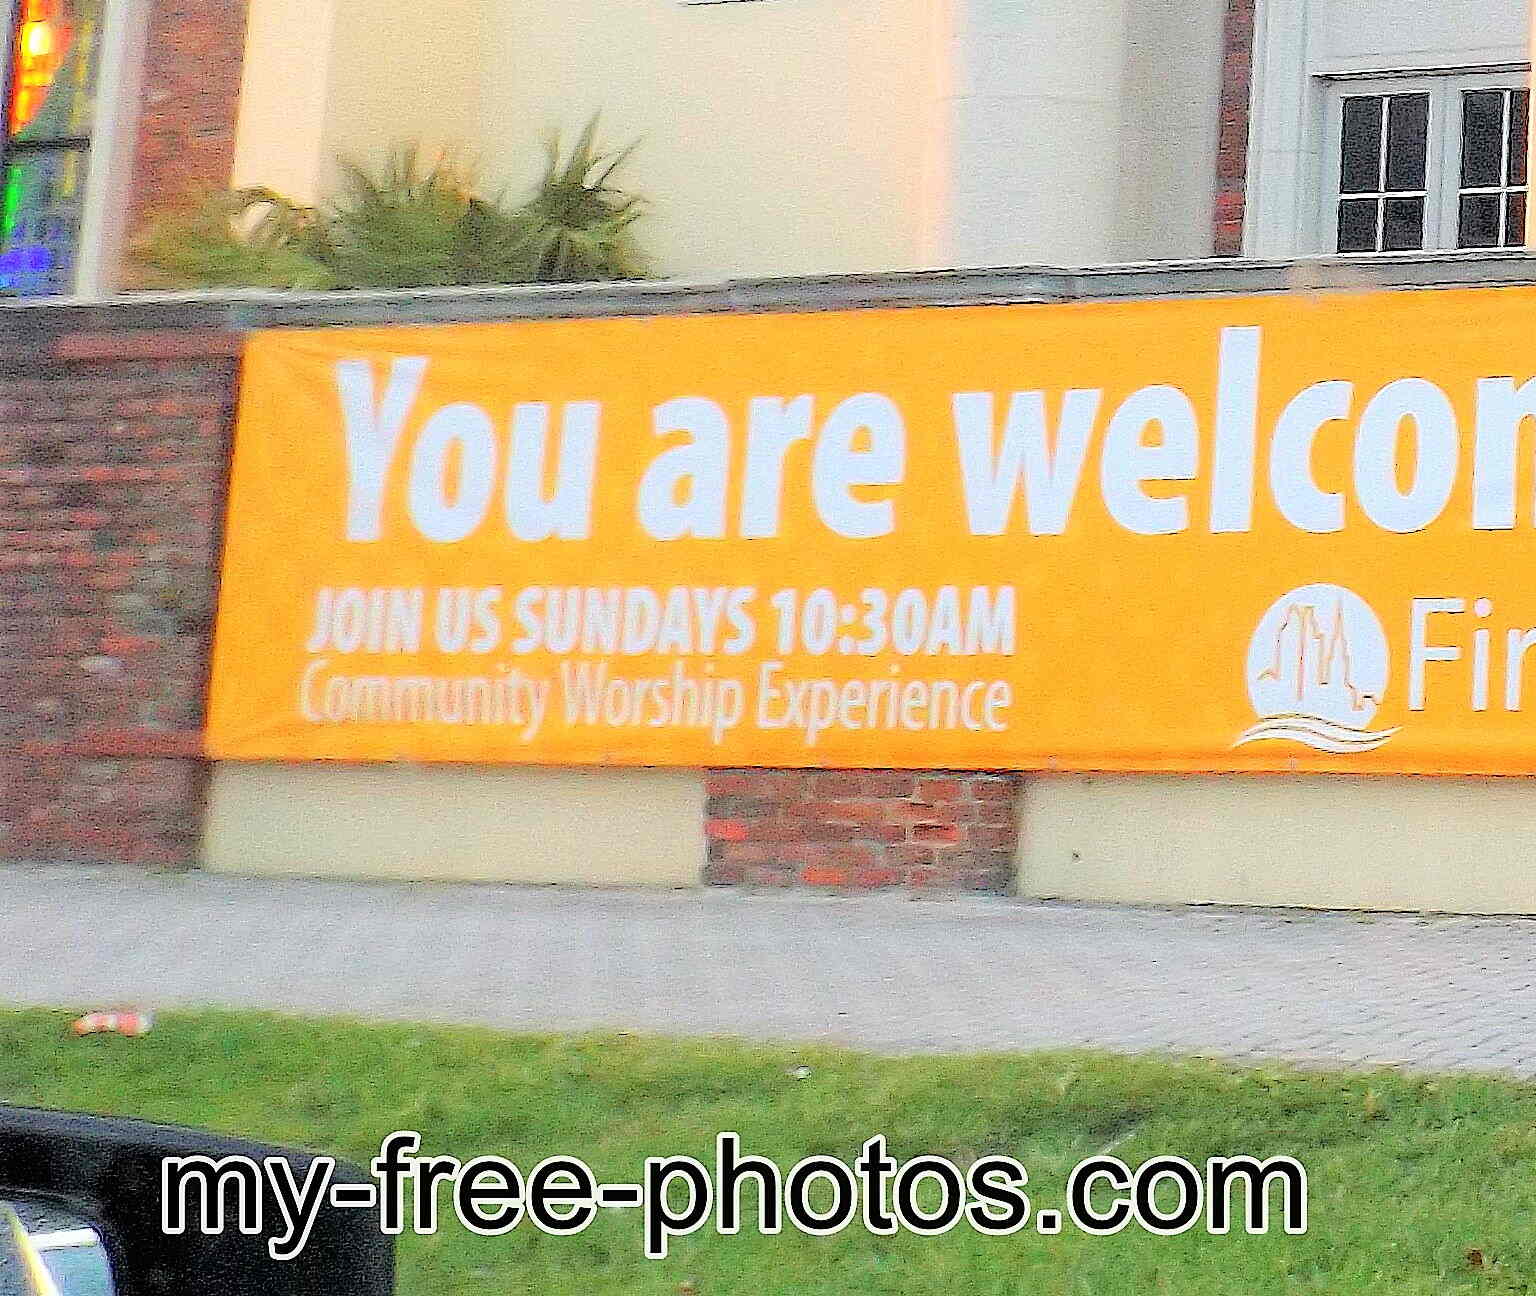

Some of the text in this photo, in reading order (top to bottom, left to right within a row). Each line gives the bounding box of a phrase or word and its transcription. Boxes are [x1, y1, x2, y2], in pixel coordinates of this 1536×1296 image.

[331, 355, 603, 543] You
[635, 392, 907, 541] are
[306, 585, 1016, 656] JOIN US SUNDAYS 10:30AM
[301, 659, 1012, 744] Community Worship Experience
